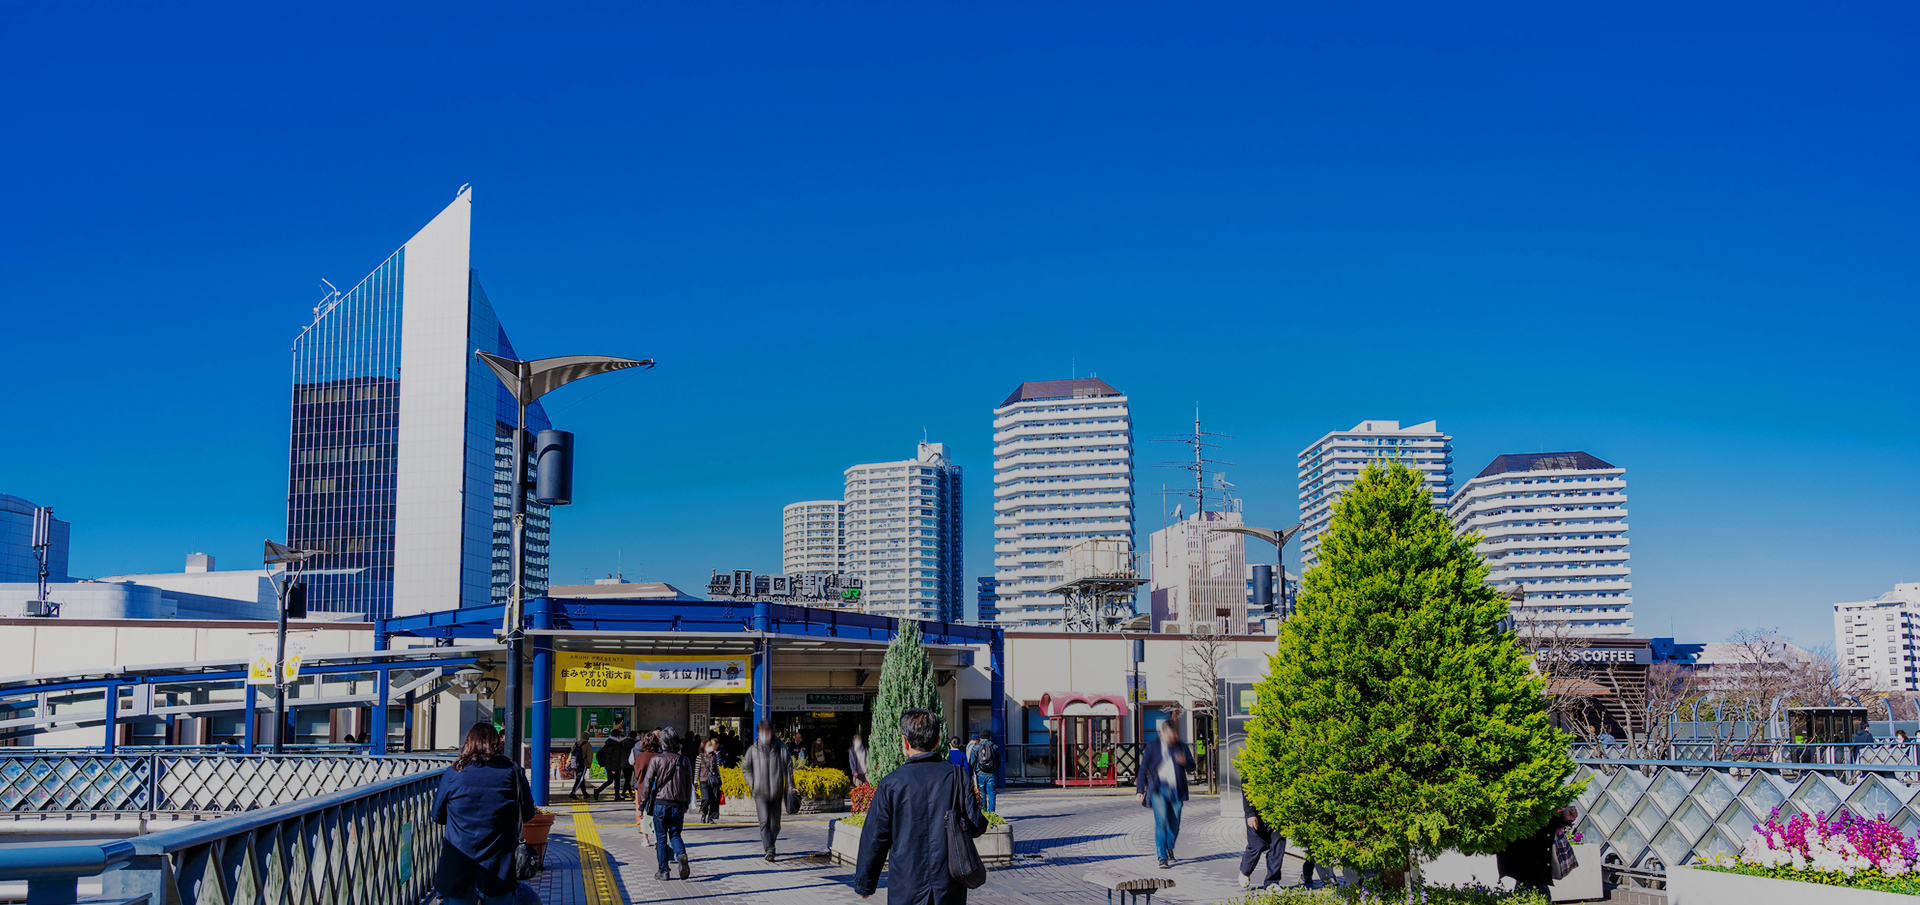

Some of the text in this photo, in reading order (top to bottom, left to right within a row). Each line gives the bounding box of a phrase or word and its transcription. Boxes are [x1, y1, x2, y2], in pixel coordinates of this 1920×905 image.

[728, 570, 827, 598] 川口駅
[841, 577, 861, 588] 東口
[842, 588, 860, 598] JR
[741, 595, 817, 604] Kawaguchi Station
[1583, 650, 1635, 662] COFFEE
[583, 662, 610, 670] 本当に
[561, 669, 632, 679] 住みやすい街大賞
[585, 678, 608, 687] 2020
